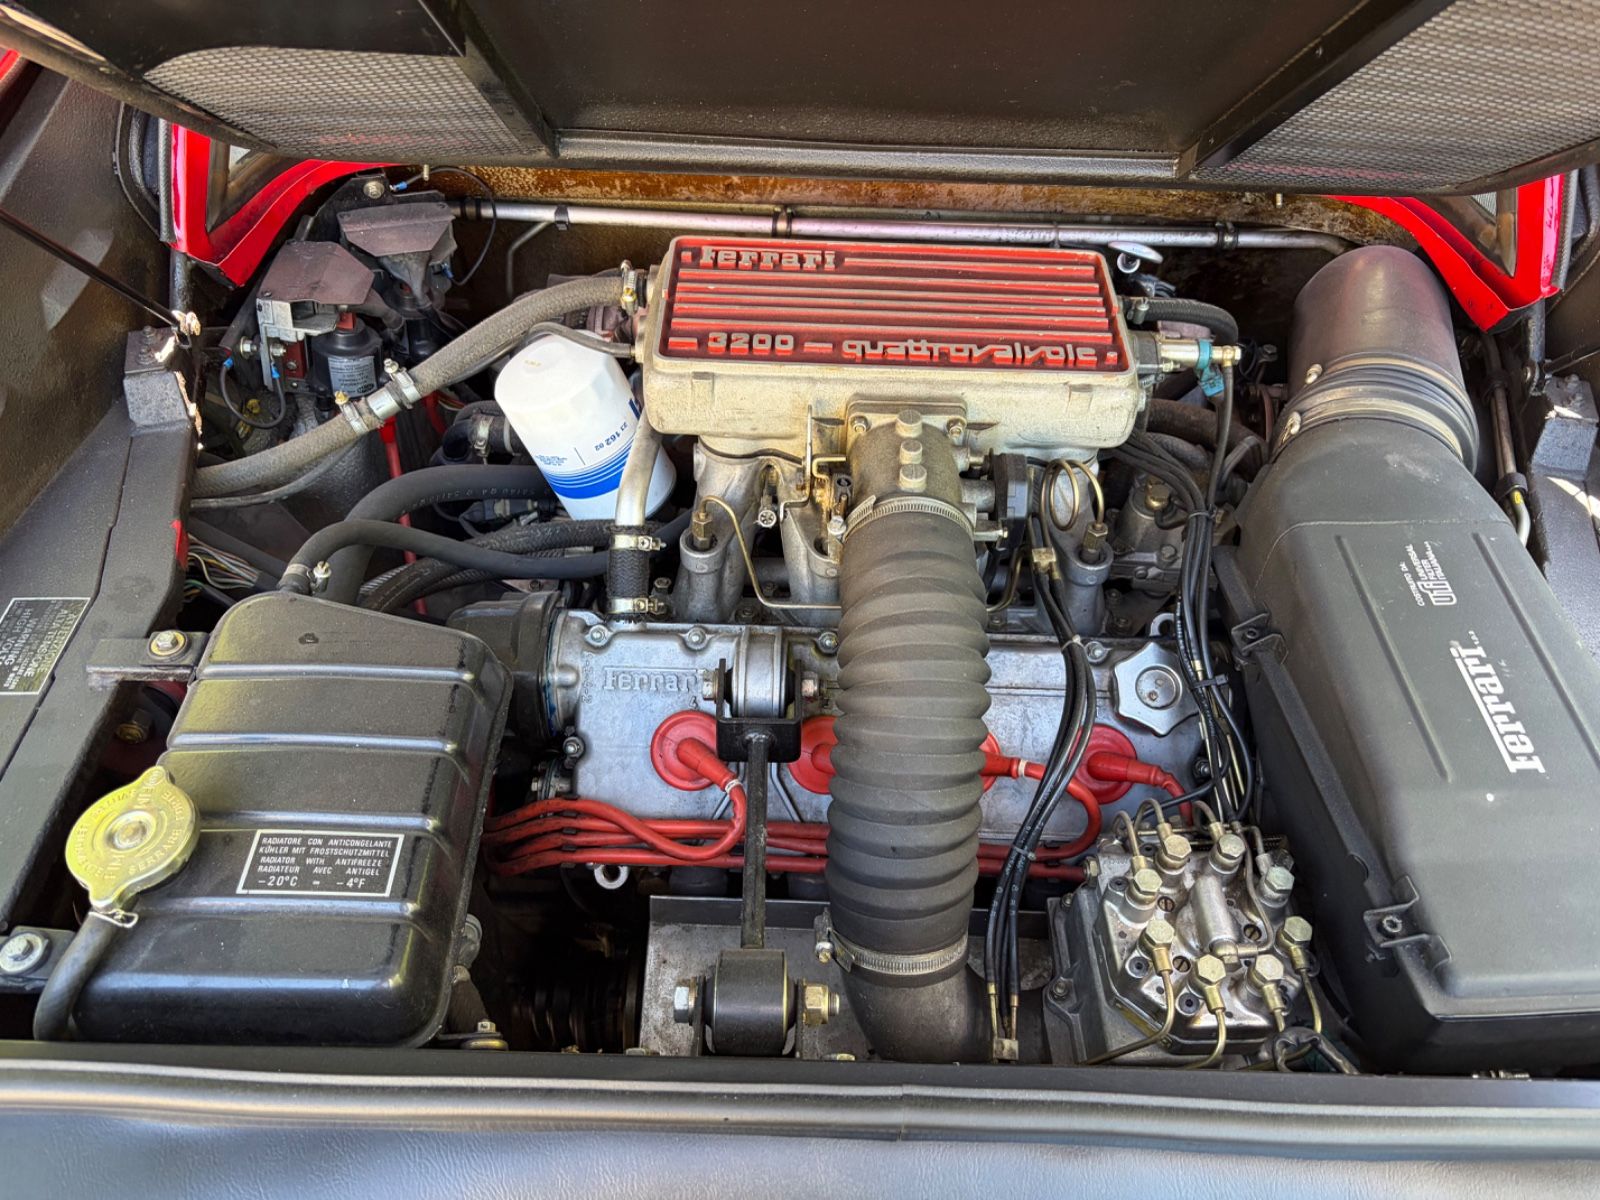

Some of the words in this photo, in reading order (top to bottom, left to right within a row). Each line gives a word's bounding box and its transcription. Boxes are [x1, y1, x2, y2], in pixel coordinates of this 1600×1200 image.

[708, 332, 794, 355] 3200
[842, 339, 1097, 368] quattrovalvole
[605, 431, 621, 446] 162
[1405, 544, 1428, 580] UNIVERSAL
[1421, 560, 1437, 580] FILTER
[12, 608, 33, 632] HIGH
[4, 618, 38, 665] WARNING
[1450, 642, 1546, 773] Ferrari
[261, 837, 301, 845] RADIATORE
[328, 839, 393, 848] ANTICONGELANTE
[309, 847, 390, 857] FROSTSCHUTZMITTEL
[260, 856, 296, 864] RADIATOR
[305, 857, 325, 865] WITH
[335, 859, 383, 867] ANTIFREEZE
[346, 868, 380, 876] ANTIGEL
